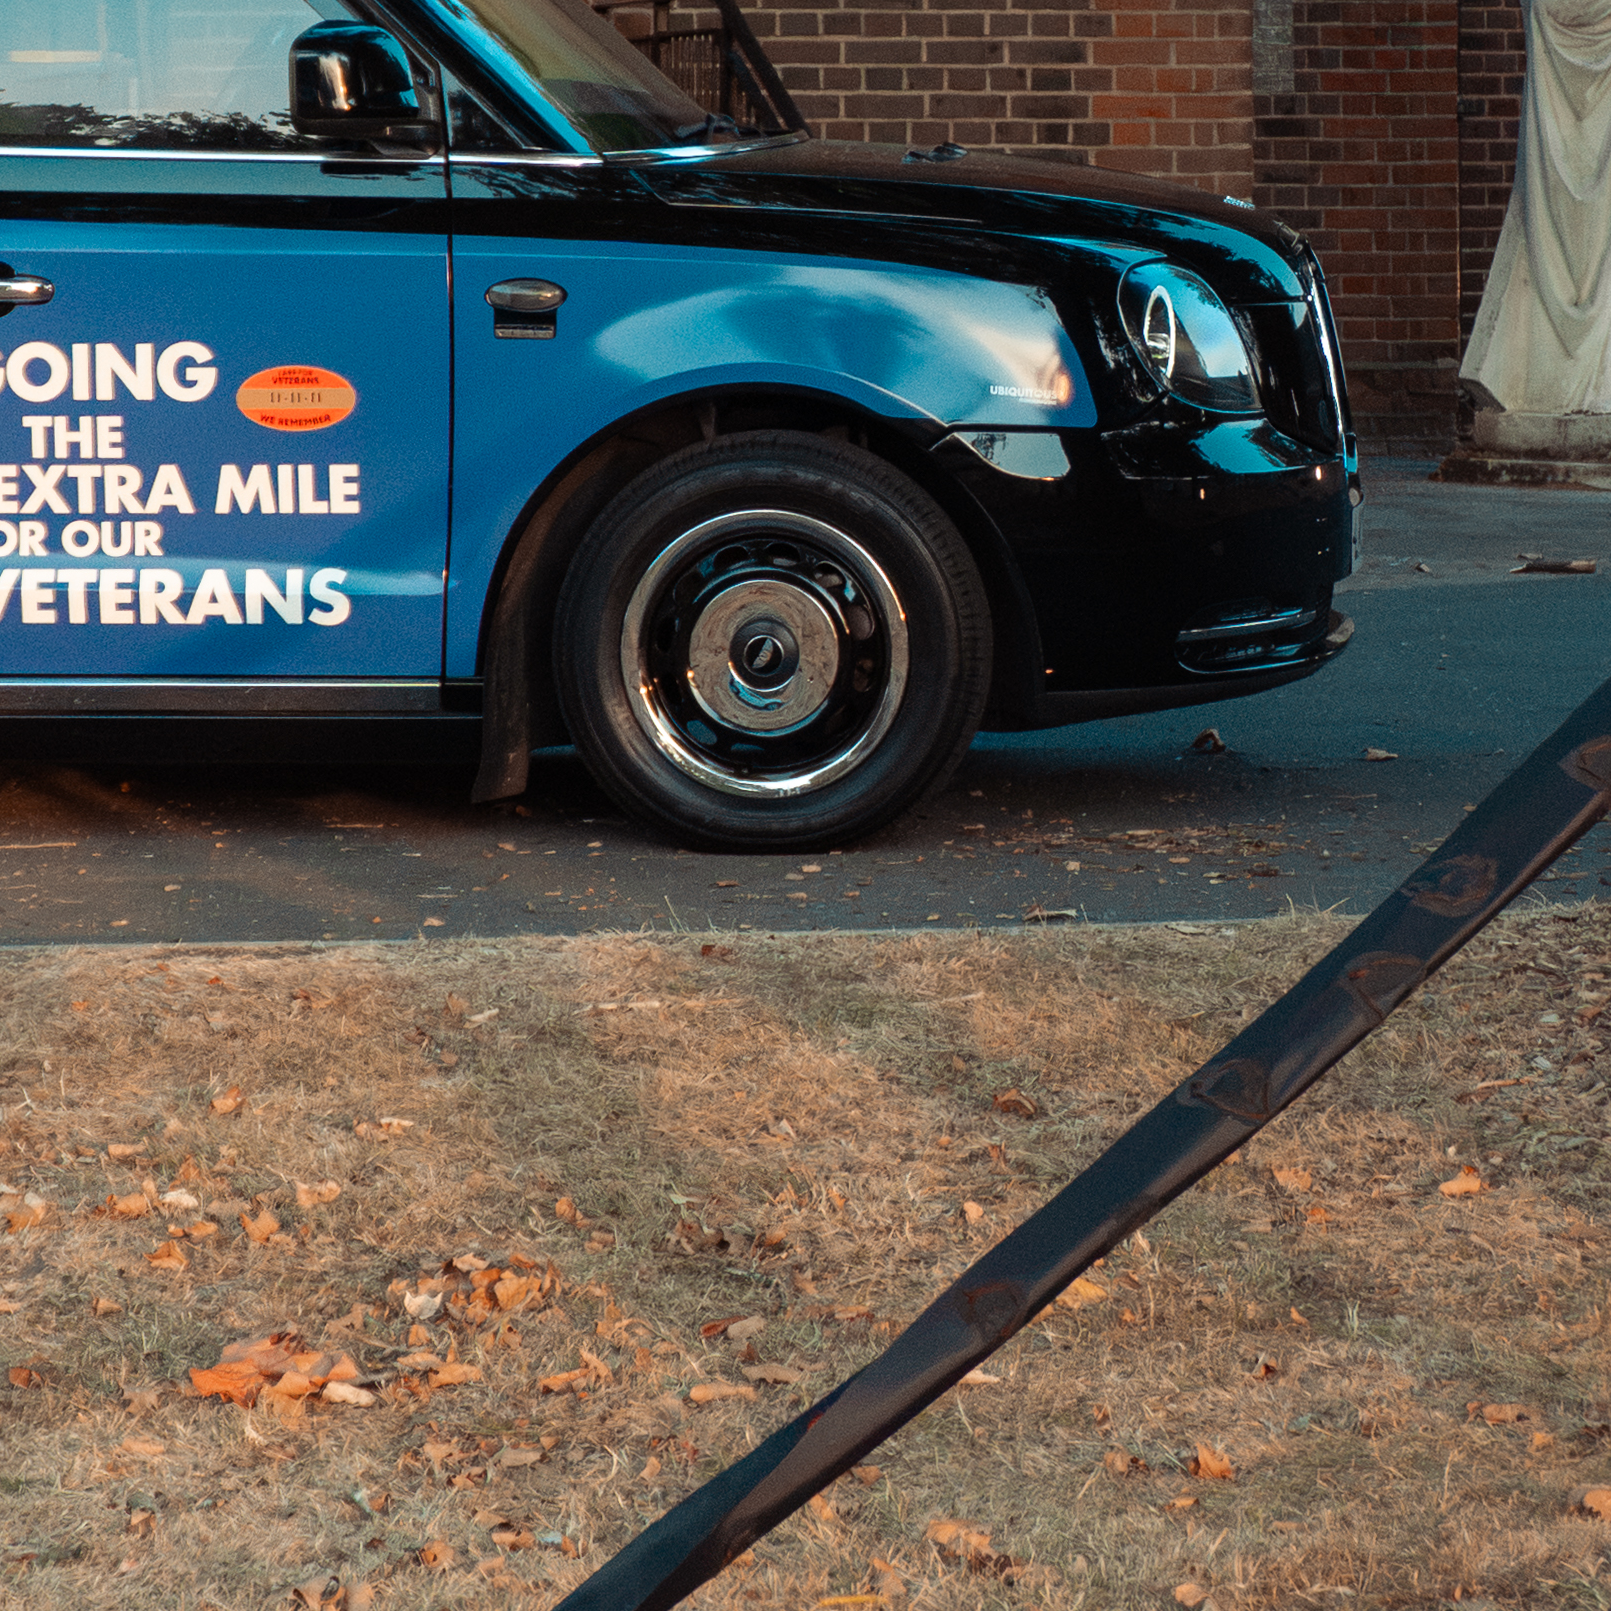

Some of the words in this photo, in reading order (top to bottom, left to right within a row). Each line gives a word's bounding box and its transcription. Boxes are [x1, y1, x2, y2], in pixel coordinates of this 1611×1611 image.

[271, 377, 320, 385] VETERANS
[989, 384, 1058, 400] UBIQUITOUS
[277, 414, 331, 426] REMEMBER
[21, 415, 126, 459] THE
[214, 463, 361, 514] MILE
[61, 519, 164, 558] OUR
